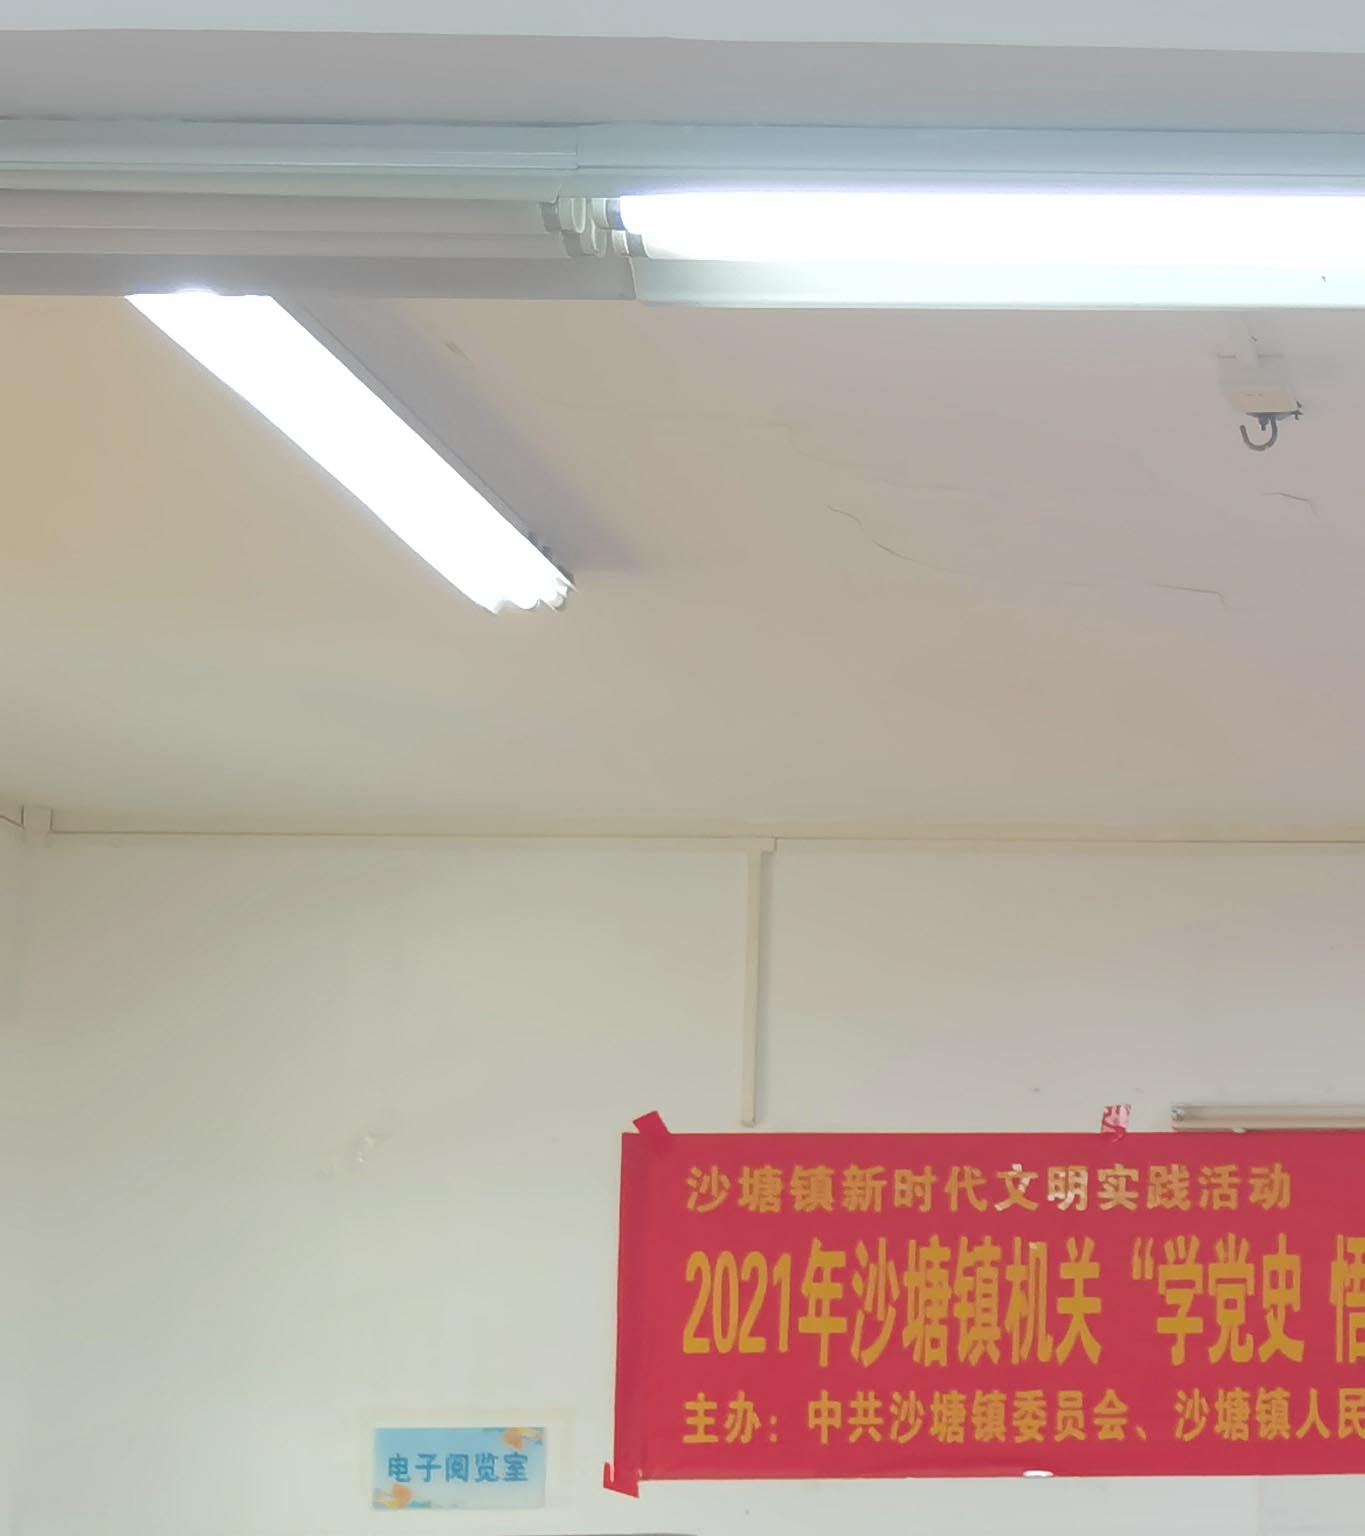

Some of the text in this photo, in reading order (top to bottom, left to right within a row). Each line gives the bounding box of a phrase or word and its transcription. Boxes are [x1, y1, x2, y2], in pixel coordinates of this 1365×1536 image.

[688, 1163, 1290, 1213] 沙塘镇新时代文明实践活动
[388, 1452, 529, 1483] 电子阅览室
